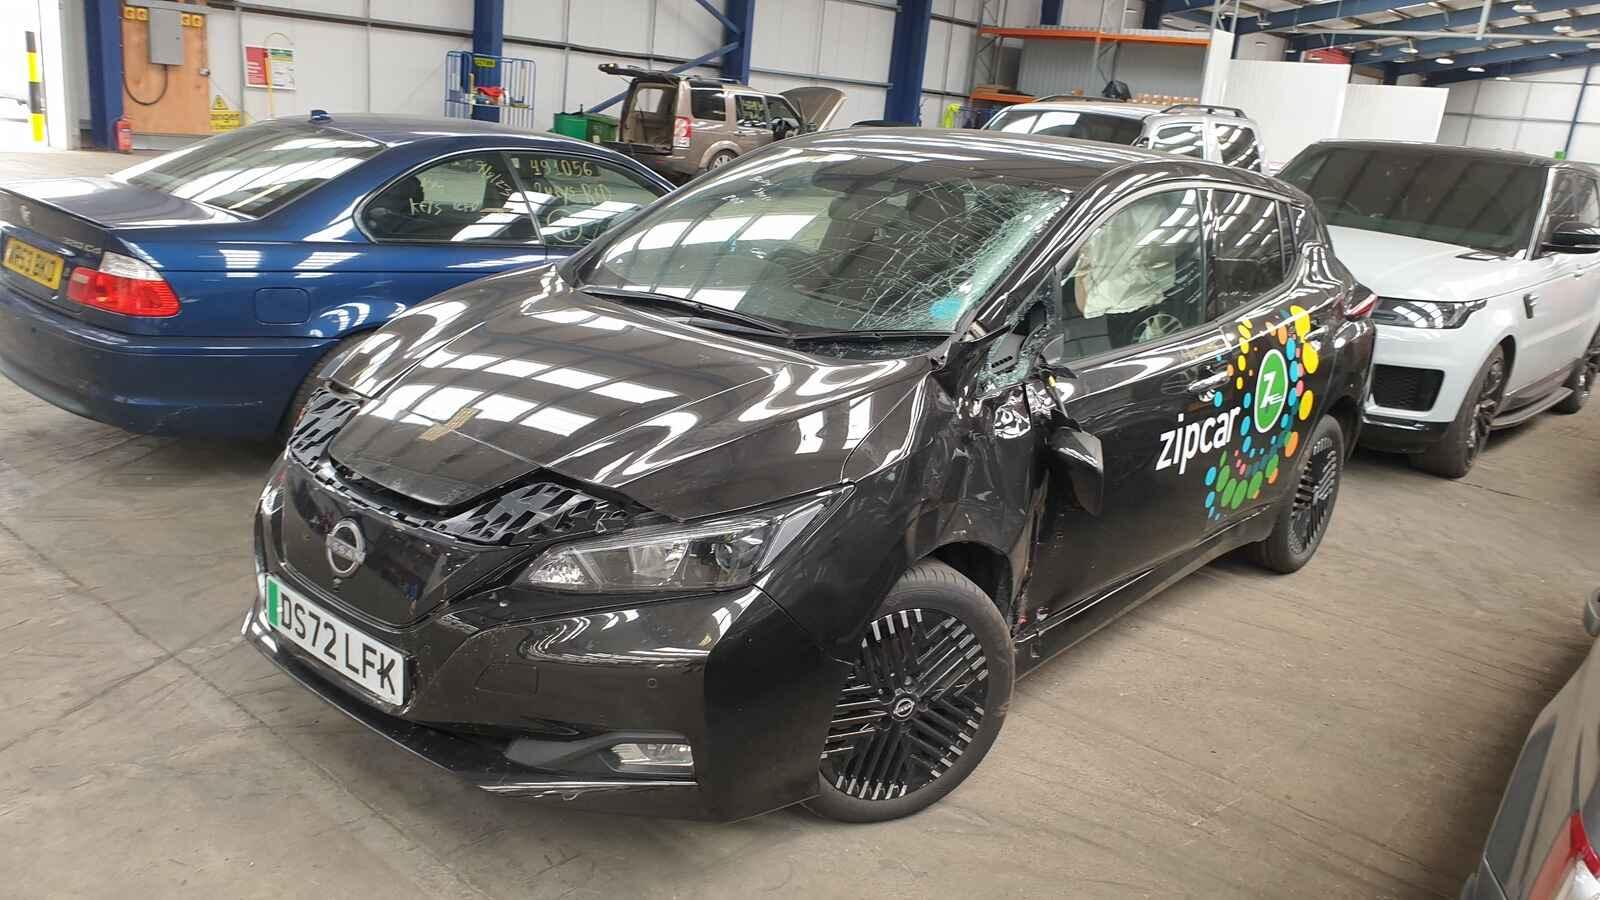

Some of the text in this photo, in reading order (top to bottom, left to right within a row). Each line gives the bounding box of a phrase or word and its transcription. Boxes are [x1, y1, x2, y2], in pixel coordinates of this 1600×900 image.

[1155, 406, 1241, 475] zipcar
[280, 592, 396, 695] DS72 LFK
